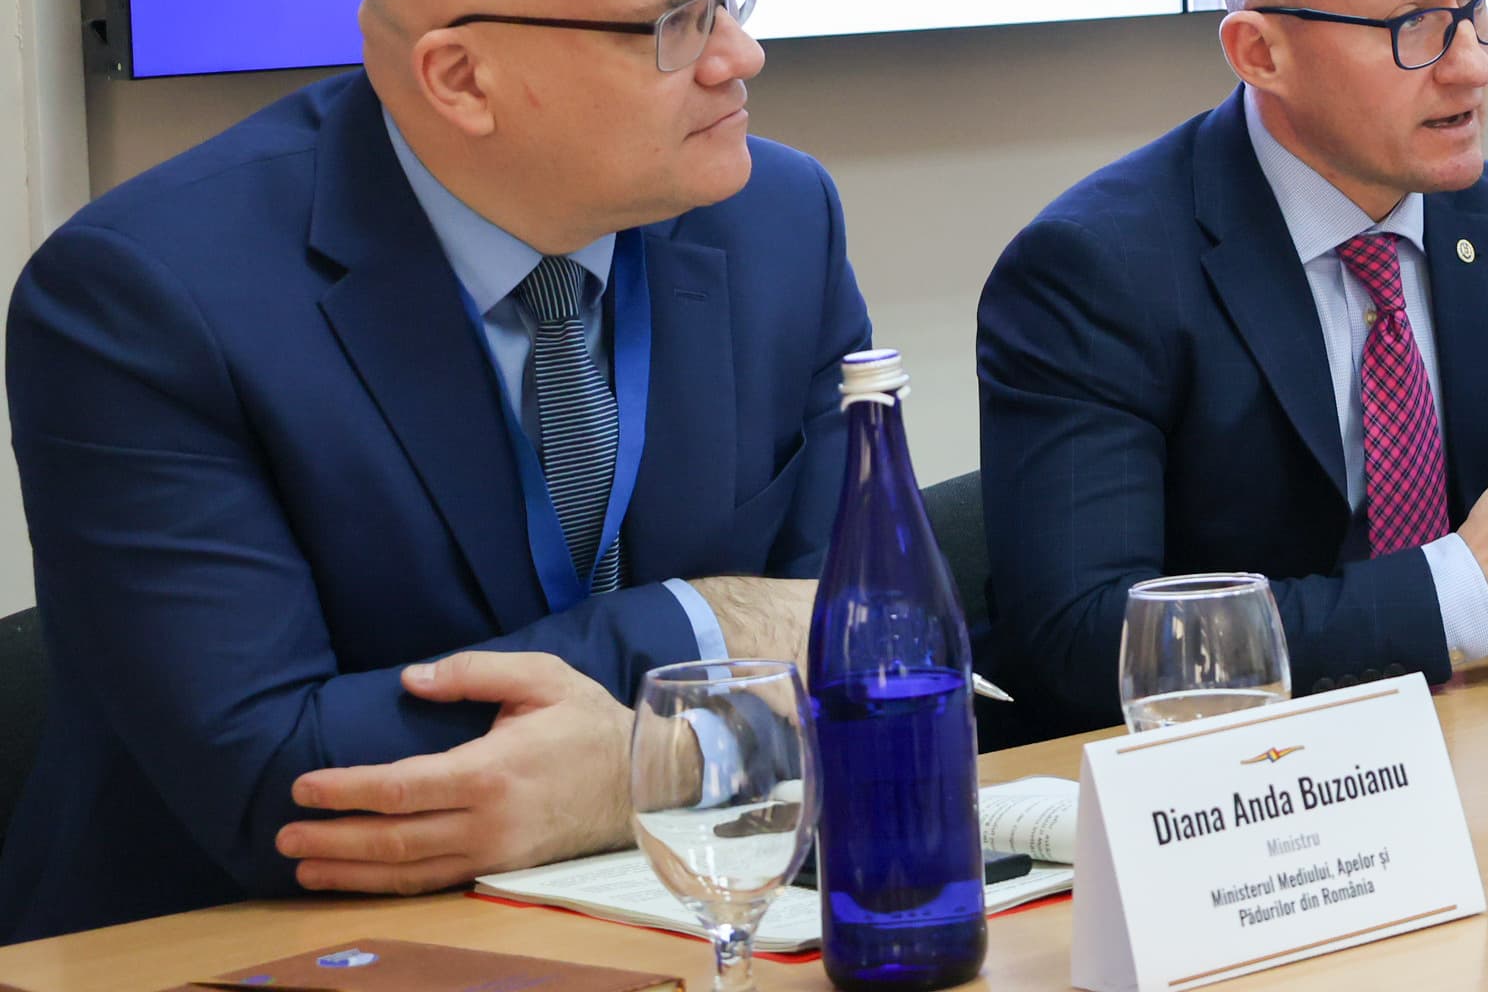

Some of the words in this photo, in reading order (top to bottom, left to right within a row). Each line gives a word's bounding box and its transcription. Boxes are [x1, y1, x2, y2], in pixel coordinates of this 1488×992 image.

[1152, 805, 1225, 846] Diana
[1233, 785, 1294, 827] Anda
[1298, 762, 1409, 811] Buzoianu
[1267, 832, 1320, 858] Ministru
[1211, 876, 1275, 908] Ministerul
[1277, 863, 1335, 891] Mediului,
[1337, 852, 1375, 879] Apelor
[1239, 897, 1296, 927] Pădurilor
[1300, 892, 1319, 912] din
[1321, 878, 1375, 905] România
